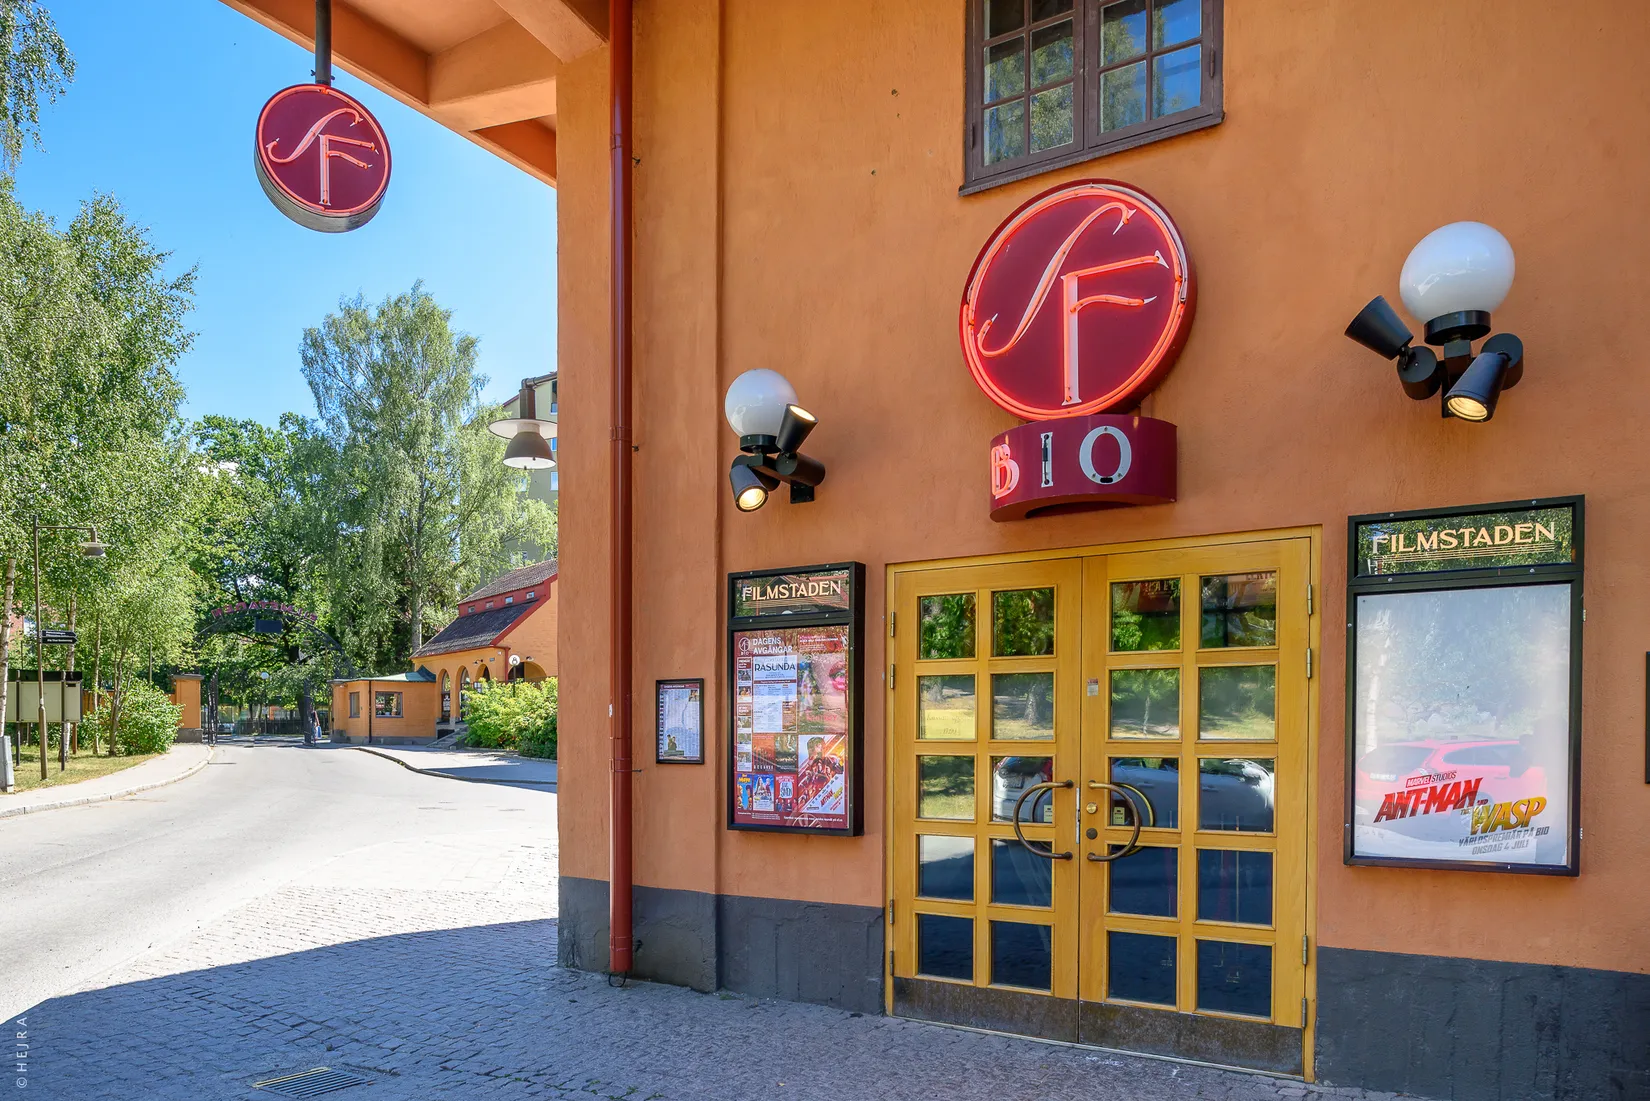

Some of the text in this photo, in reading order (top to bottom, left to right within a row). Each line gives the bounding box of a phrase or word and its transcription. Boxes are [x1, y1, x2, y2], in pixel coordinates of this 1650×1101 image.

[990, 425, 1132, 499] BIO
[1373, 521, 1556, 554] FILMSTADEN
[742, 580, 841, 601] FILMSTADEN
[752, 636, 782, 646] DAGENS
[752, 644, 793, 655] AVGÅNGAR
[1407, 776, 1431, 787] MARVEL
[1432, 771, 1457, 782] STUDIOS
[1373, 777, 1484, 823] ANT-MAN
[1470, 796, 1547, 836] WASP
[1522, 827, 1534, 840] PÅ
[1535, 826, 1550, 837] BIO
[1471, 839, 1529, 855] ONSDAG 4 JULI
